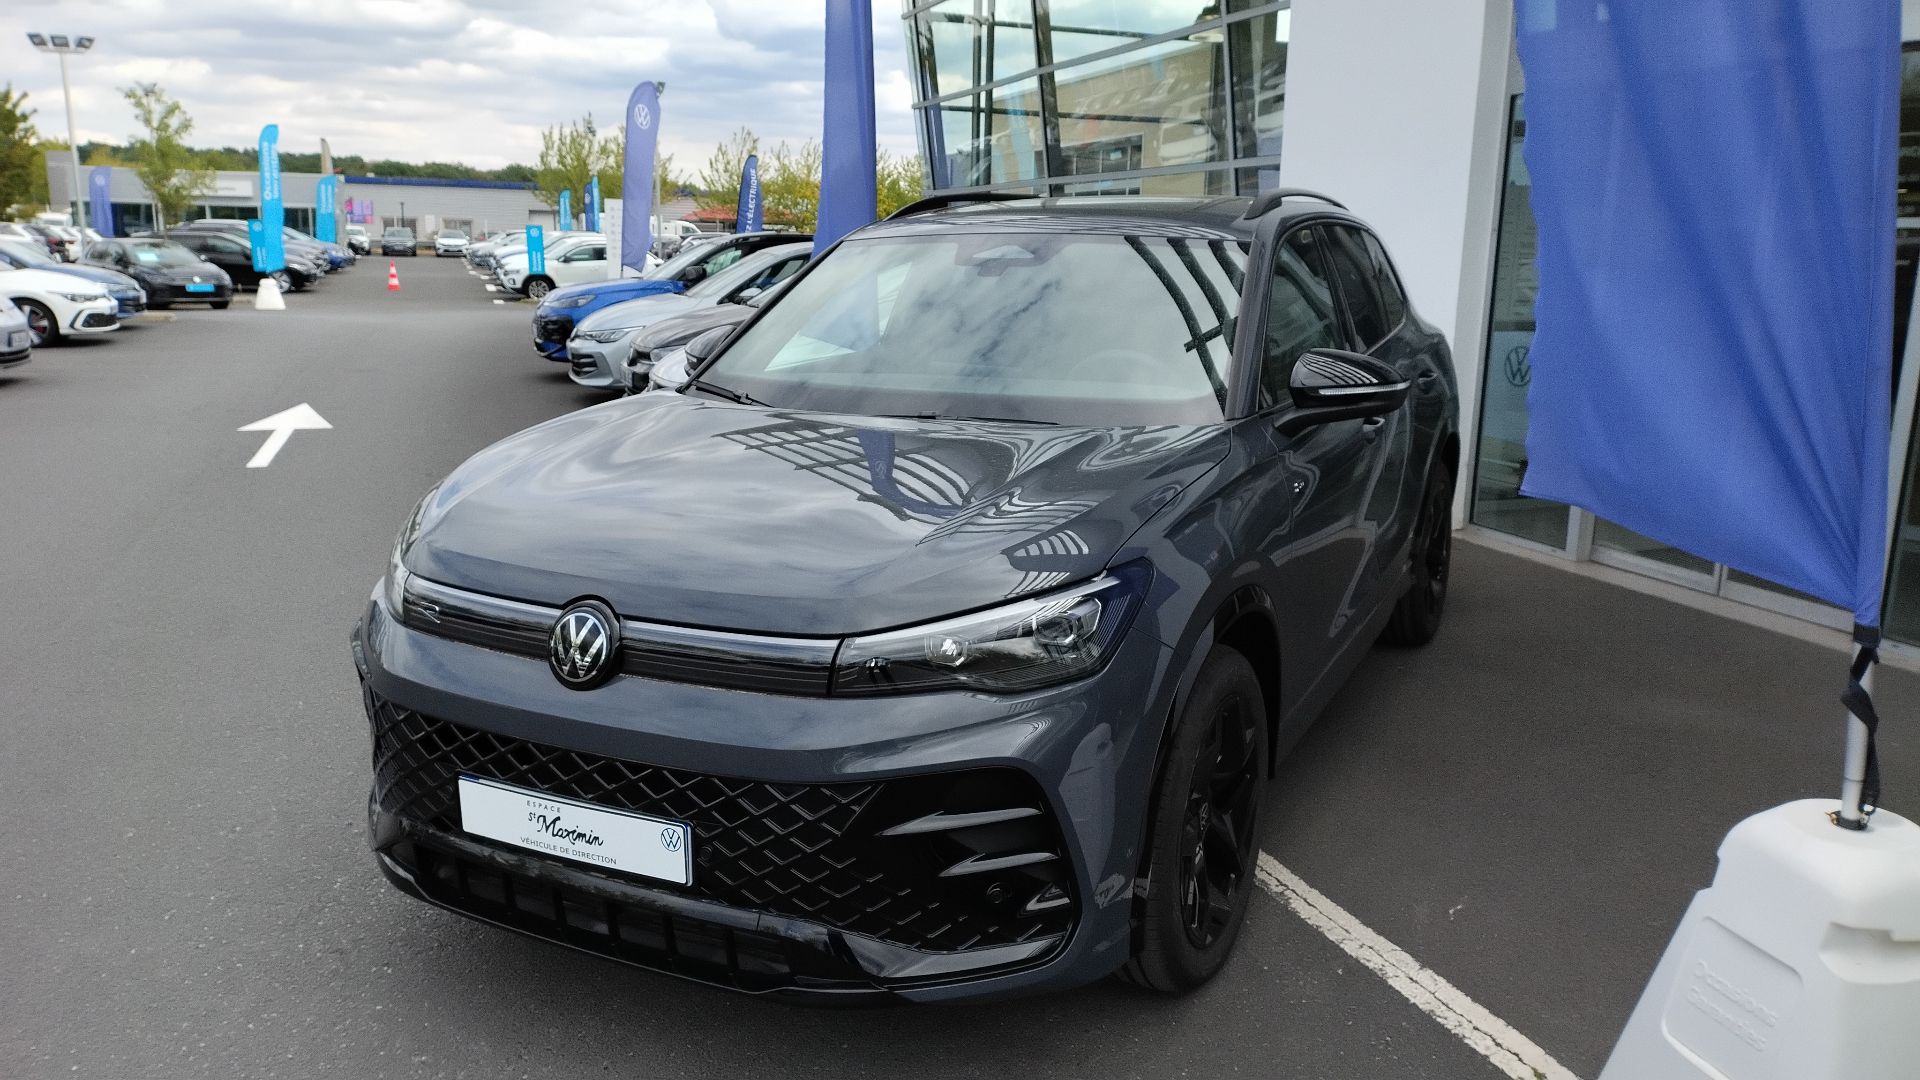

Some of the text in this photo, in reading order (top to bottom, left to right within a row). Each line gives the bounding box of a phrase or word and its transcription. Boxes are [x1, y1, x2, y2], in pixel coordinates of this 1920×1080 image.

[526, 800, 561, 813] ESPACE
[536, 814, 604, 846] Maximin
[520, 837, 617, 865] VÉHICULE DE DIRECTION
